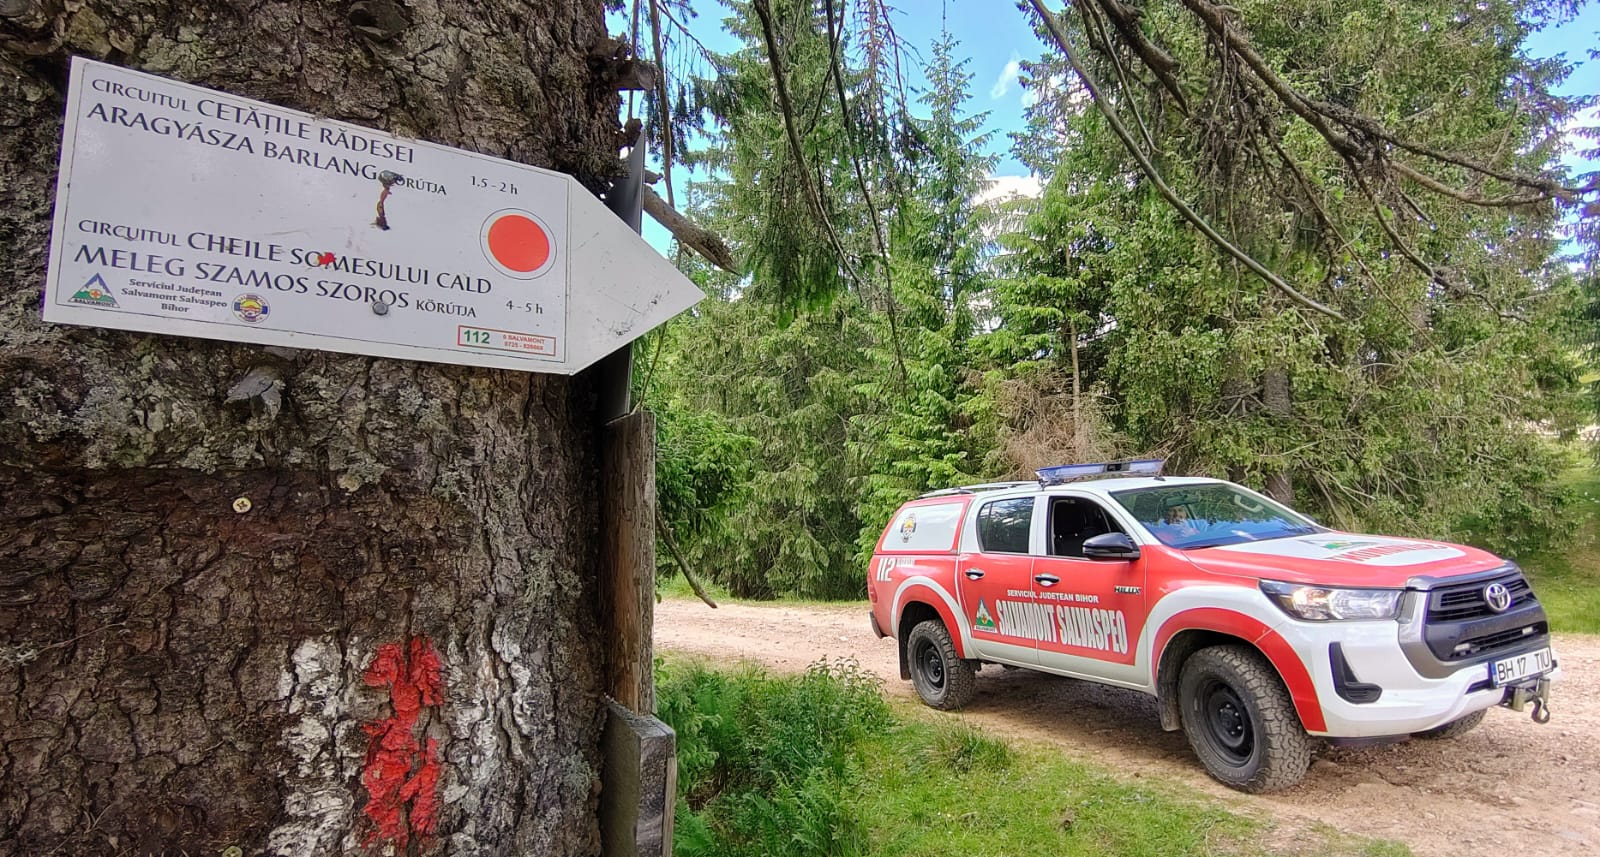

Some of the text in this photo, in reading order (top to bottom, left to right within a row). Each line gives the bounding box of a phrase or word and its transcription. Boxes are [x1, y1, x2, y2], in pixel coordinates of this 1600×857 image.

[92, 78, 190, 112] CIRCUITUL
[319, 127, 414, 164] RĂDESEI
[87, 102, 255, 154] ARAGYÁSZA
[263, 141, 377, 181] BARLANG
[78, 219, 182, 247] CIRCUITUL
[187, 232, 282, 262] CHEILE
[436, 272, 492, 295] CALD
[74, 244, 477, 318] MELEG SZAMOS SZOROS KÖRÚTJA
[129, 278, 174, 291] Serviciul
[120, 287, 228, 308] Salvamont Salvaspeo
[160, 302, 190, 313] Bihor
[463, 329, 491, 345] 112
[876, 557, 897, 582] 112
[1006, 589, 1038, 599] SERVICIUL
[1075, 593, 1100, 604] BIHOR
[995, 599, 1128, 655] SALVAMONT SALVASPEO
[1497, 650, 1550, 681] BH 17 TIU
